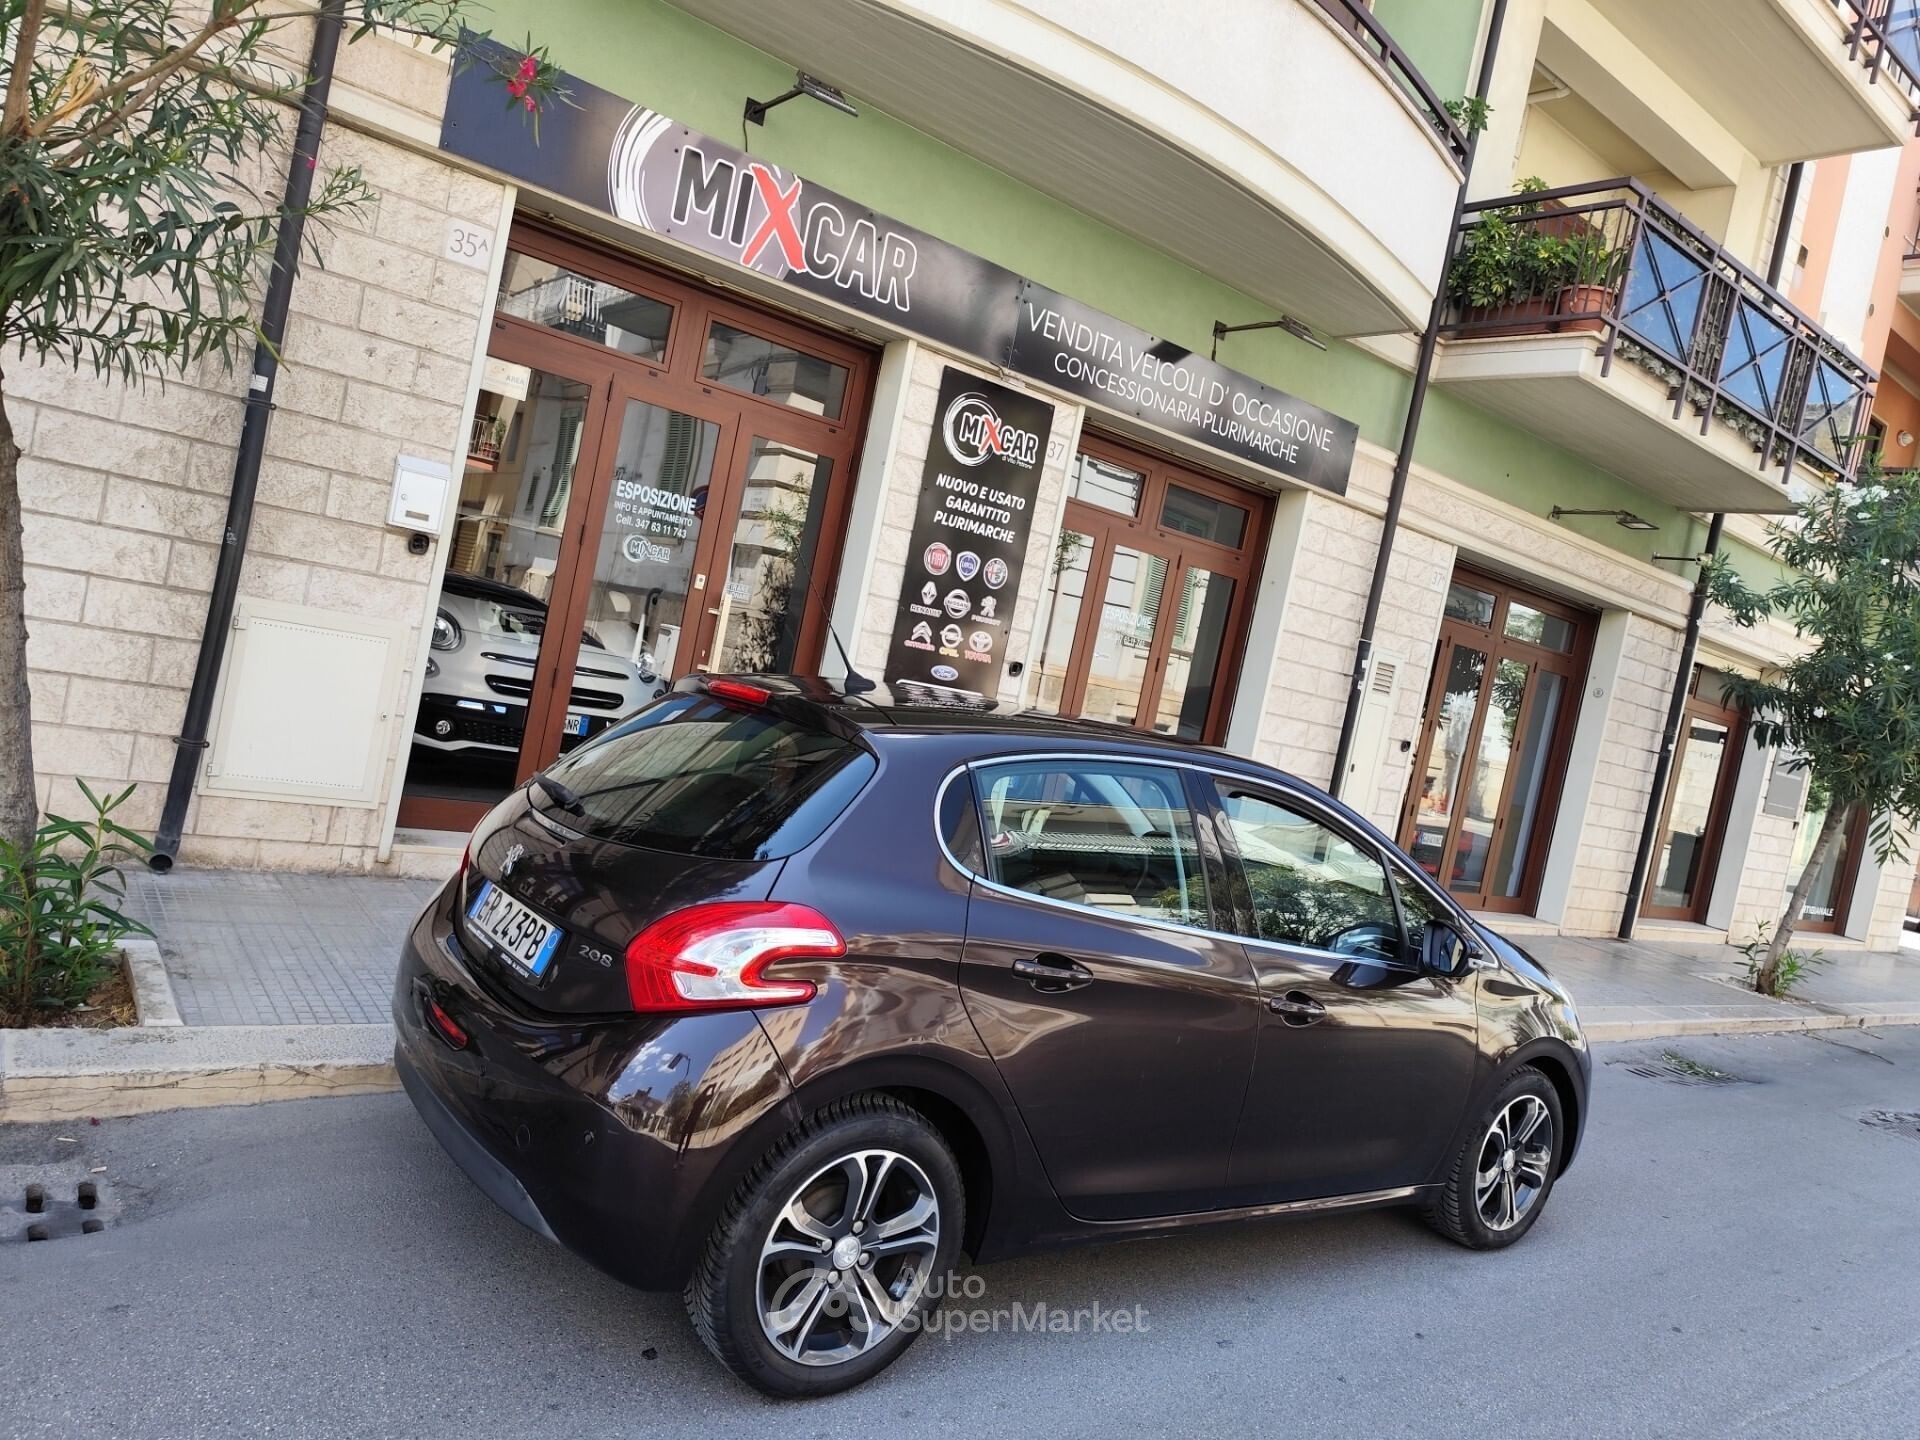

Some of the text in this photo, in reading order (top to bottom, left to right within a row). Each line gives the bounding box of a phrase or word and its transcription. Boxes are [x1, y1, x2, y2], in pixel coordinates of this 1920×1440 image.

[671, 144, 918, 312] MIXCAR
[1028, 301, 1124, 368] VENDITA
[1128, 344, 1206, 400] VEICOLI
[1232, 392, 1334, 452] OCCASIONE
[1053, 352, 1300, 465] CONCESSIONARIA PLURIMARCHE
[958, 411, 1039, 464] MIXCAR
[1047, 440, 1065, 462] 37
[616, 479, 697, 515] ESPOSIZIONE
[935, 473, 1026, 510] NUOVO E USATO
[614, 500, 693, 527] INFO E APPUNTAMENTO
[615, 513, 634, 527] Cell.
[635, 518, 649, 530] 347
[651, 522, 661, 533] 63
[663, 525, 671, 535] 11
[945, 495, 1011, 524] GARANTITO
[933, 510, 1016, 544] PLURIMARCHE
[629, 539, 671, 561] MIXCAR
[578, 944, 613, 968] 208
